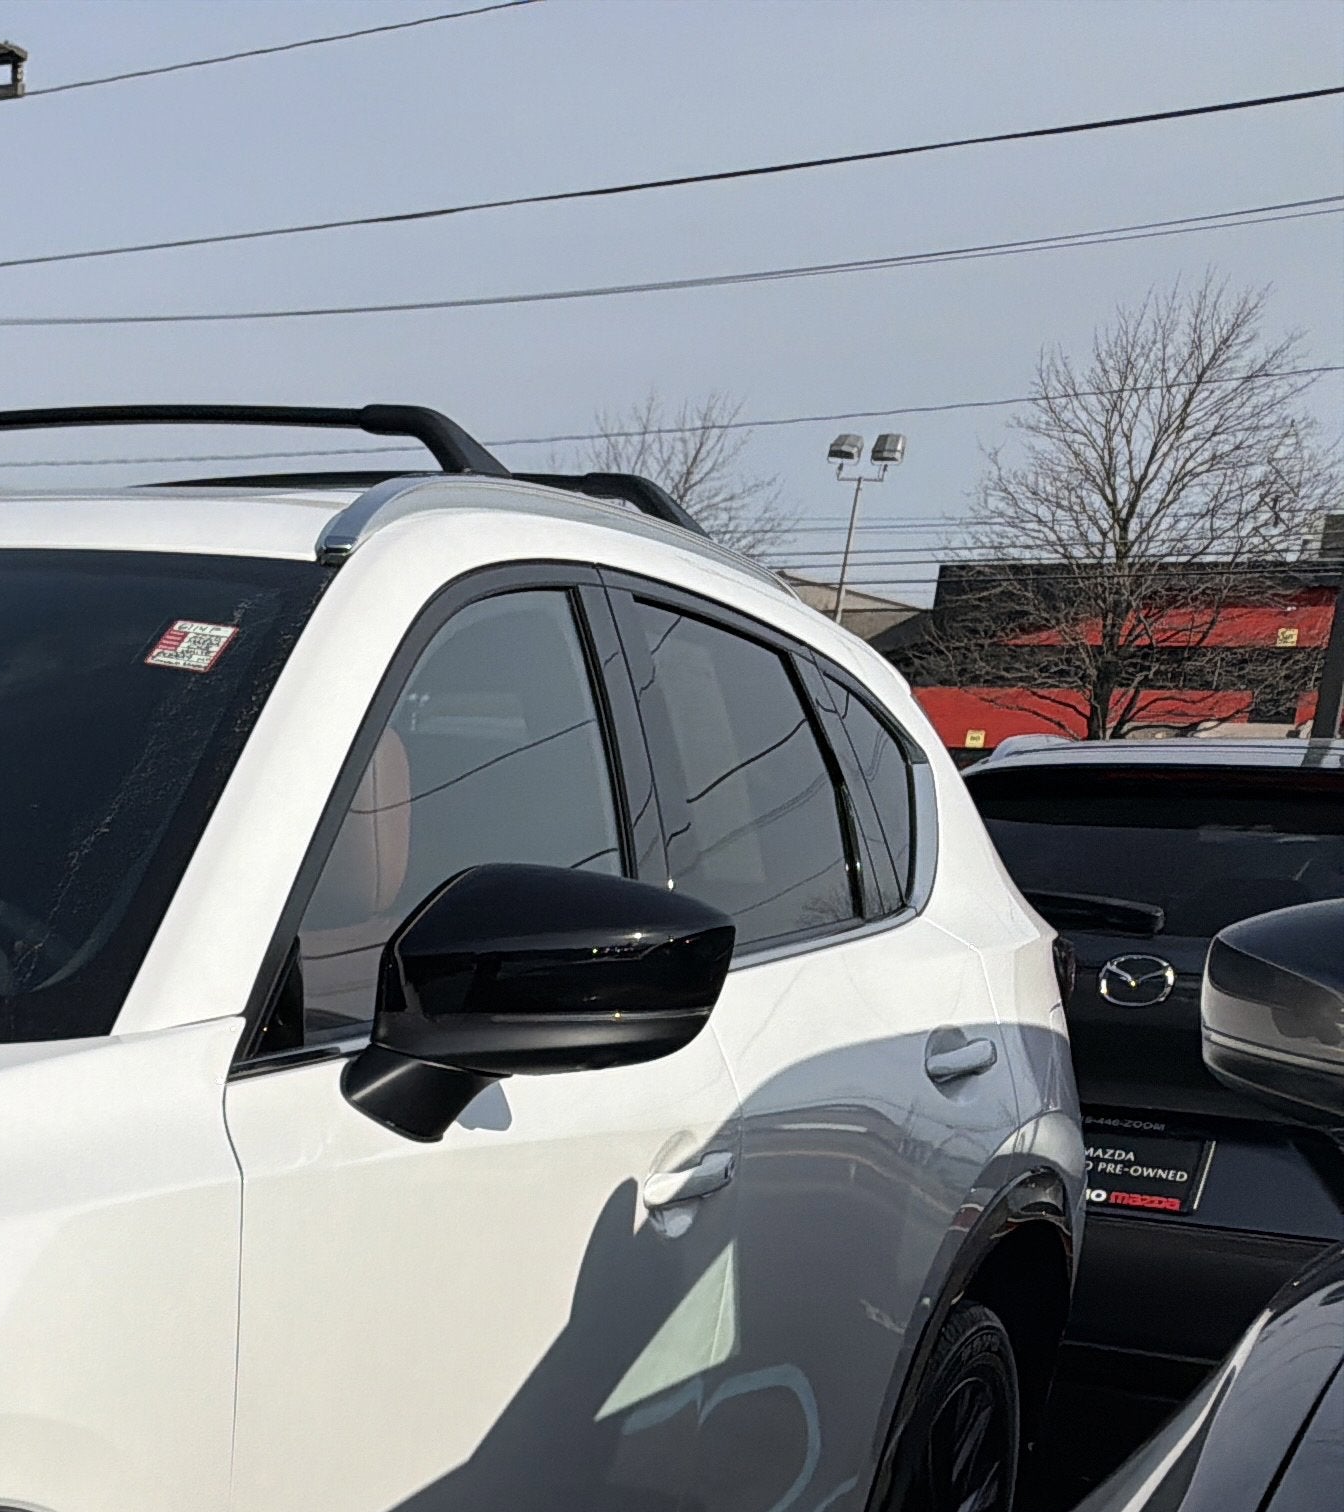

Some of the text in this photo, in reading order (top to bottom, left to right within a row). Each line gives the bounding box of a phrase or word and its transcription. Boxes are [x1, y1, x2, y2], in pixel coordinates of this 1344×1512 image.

[1085, 1146, 1135, 1162] MAZDA
[1097, 1161, 1188, 1182] PRE-OWNED
[1109, 1191, 1182, 1212] mazda
